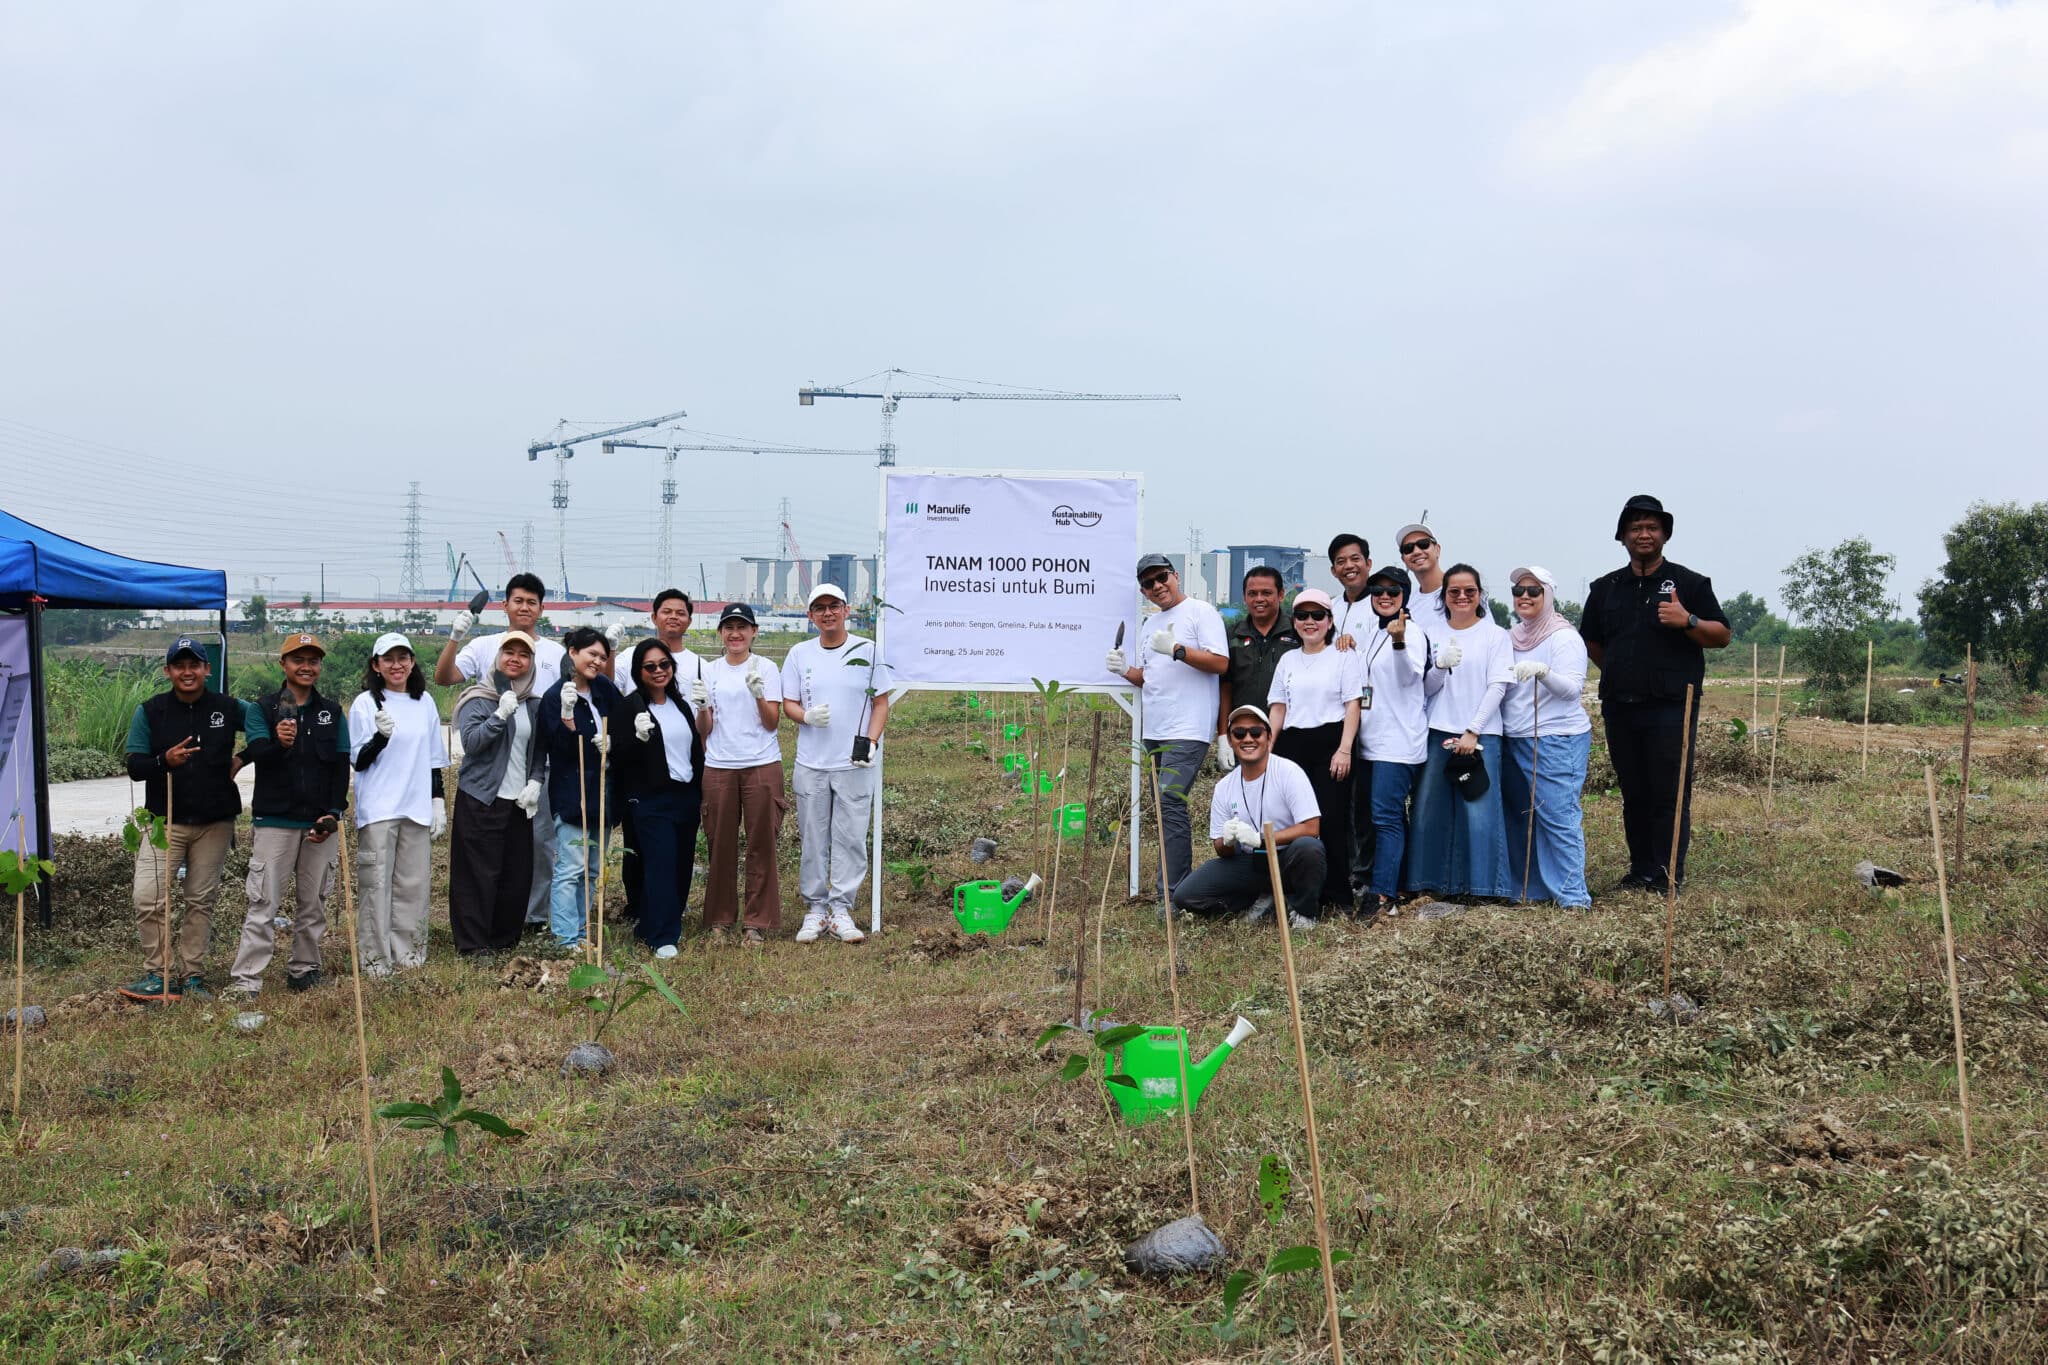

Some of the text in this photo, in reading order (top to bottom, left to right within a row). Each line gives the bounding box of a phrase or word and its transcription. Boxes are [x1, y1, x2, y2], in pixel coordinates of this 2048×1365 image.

[927, 504, 971, 515] Manulife
[1051, 510, 1103, 519] Sustainability
[1055, 518, 1071, 526] Hub
[926, 555, 1090, 573] TANAM 1000 POHON
[924, 576, 1095, 595] Investasi untuk Bumi
[924, 620, 943, 628] Jenis
[944, 620, 966, 629] pohon:
[968, 621, 996, 629] Sengon,
[997, 621, 1027, 629] Gmelina,
[1029, 621, 1046, 629] Pulai
[1054, 622, 1082, 631] Mangga
[924, 647, 956, 657] Cikarang,
[958, 648, 968, 656] 25
[969, 648, 984, 656] Juni
